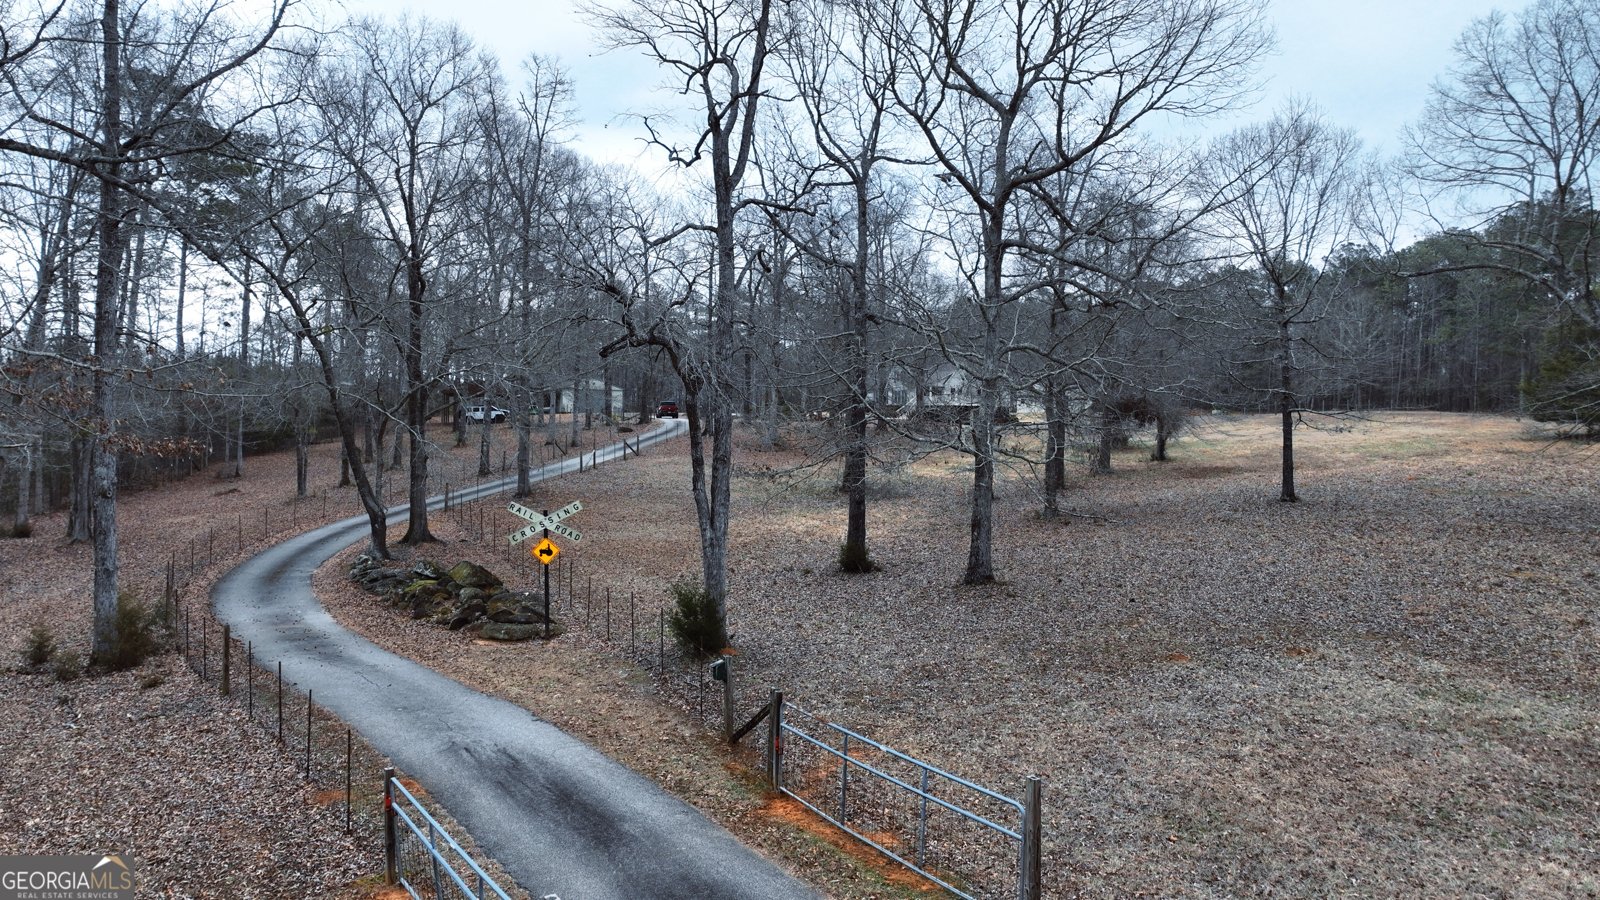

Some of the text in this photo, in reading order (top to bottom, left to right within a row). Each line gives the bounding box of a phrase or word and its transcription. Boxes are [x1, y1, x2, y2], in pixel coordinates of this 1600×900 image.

[509, 504, 580, 541] RAIL ROAD
[512, 503, 580, 542] CROSSING
